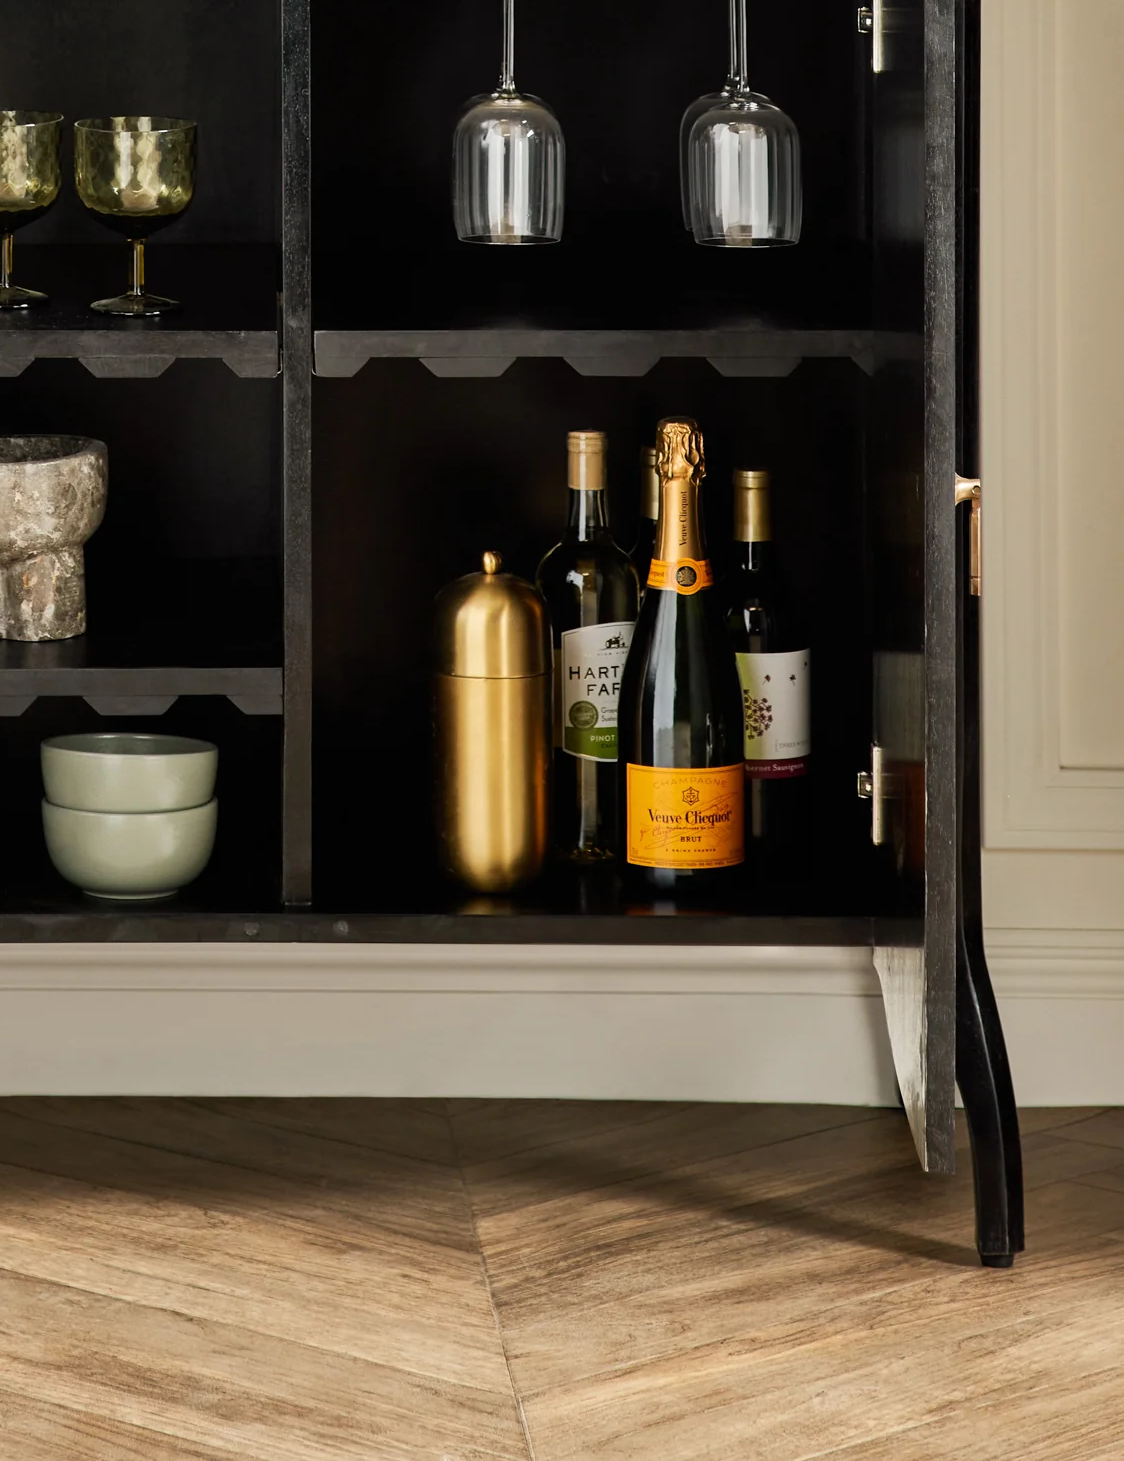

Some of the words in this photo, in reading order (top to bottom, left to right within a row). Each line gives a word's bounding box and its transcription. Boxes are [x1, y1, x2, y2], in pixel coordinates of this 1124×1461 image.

[679, 491, 689, 523] Clicquot
[679, 524, 688, 546] Veuve
[590, 734, 615, 742] PINOT
[653, 777, 728, 789] CHAMPAGNE
[648, 808, 682, 824] Veuve
[685, 809, 731, 826] Clicquot
